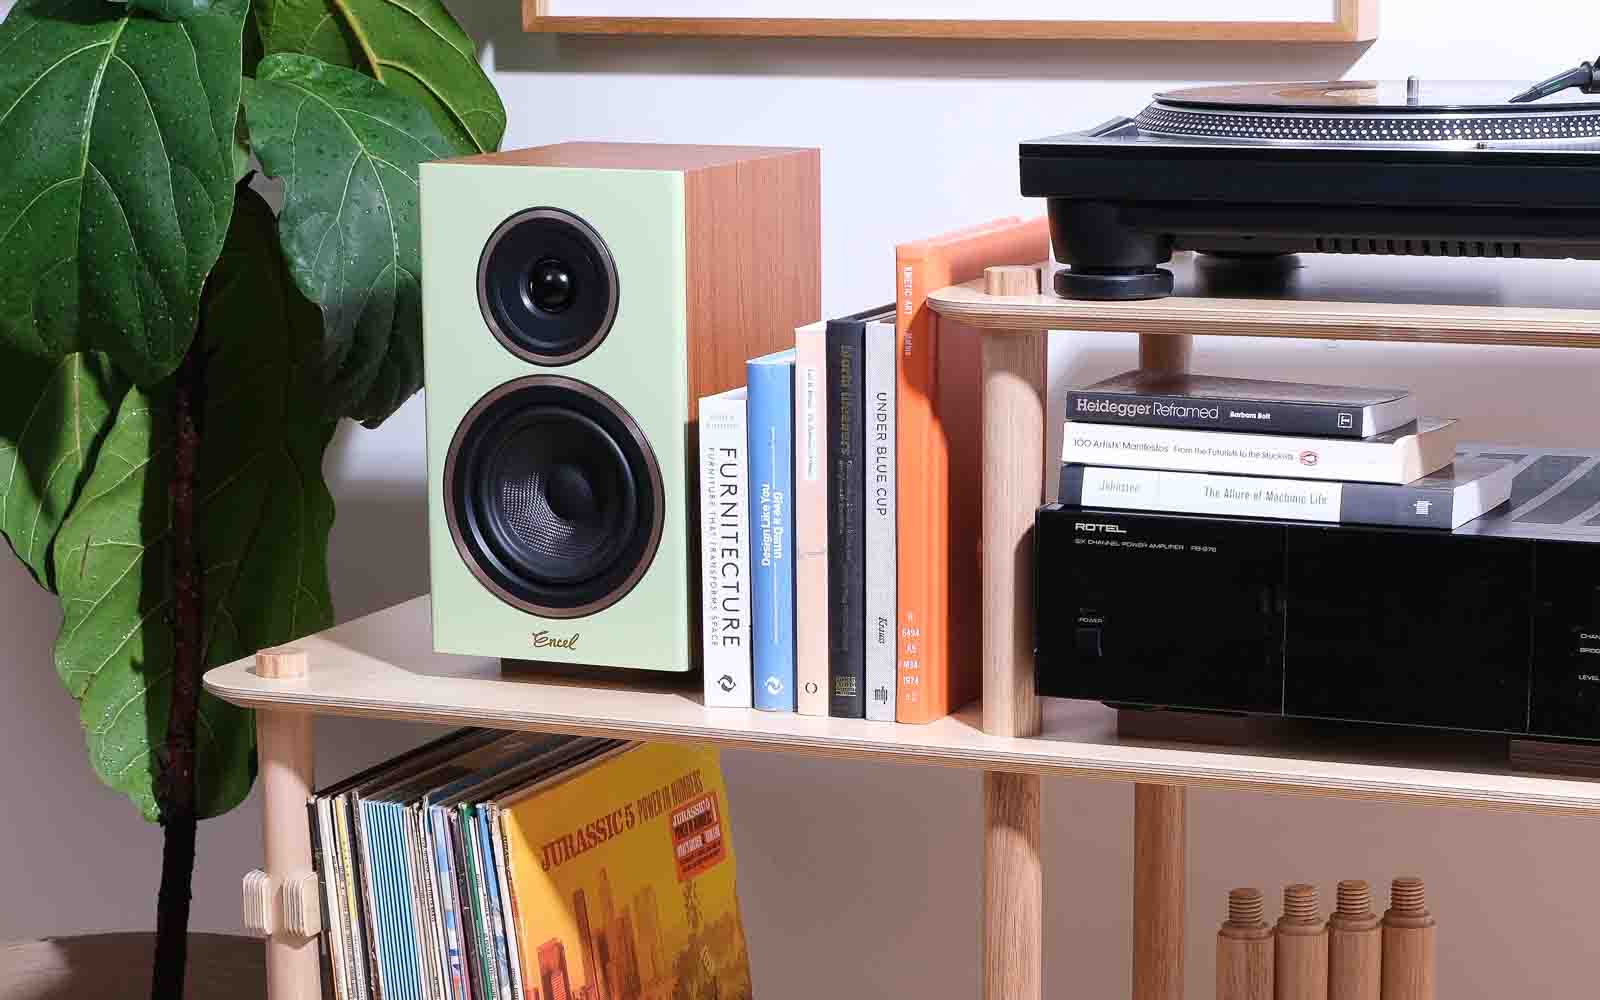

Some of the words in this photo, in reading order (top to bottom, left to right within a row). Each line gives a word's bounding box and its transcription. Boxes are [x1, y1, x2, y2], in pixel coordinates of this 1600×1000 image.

[904, 302, 912, 315] ART
[876, 392, 888, 441] UNDER
[1076, 398, 1151, 416] Heidegger
[1153, 402, 1219, 420] Reframed
[1074, 439, 1092, 448] 100
[1122, 442, 1169, 452] Manifestos
[1174, 446, 1192, 454] From
[1194, 446, 1208, 454] the
[1208, 448, 1238, 457] Futurists
[1248, 450, 1261, 458] the
[706, 447, 717, 506] FURNITURE
[876, 446, 888, 483] BLUE
[760, 483, 770, 504] You
[877, 487, 888, 517] CUP
[1204, 486, 1220, 497] The
[1223, 488, 1250, 500] Allure
[1253, 489, 1262, 501] of
[1310, 492, 1328, 504] Life
[708, 512, 718, 536] THAT
[760, 505, 770, 528] Like
[1074, 522, 1127, 534] ROTEL
[718, 448, 741, 648] FURNITECTURE
[761, 528, 772, 567] Design
[1088, 539, 1120, 547] CHANNEL
[1149, 543, 1184, 551] AMPLIFIER
[710, 541, 719, 611] TRANSFORMS
[532, 630, 580, 650] Encel
[711, 616, 719, 647] SPACE
[637, 793, 663, 825] POWER
[672, 800, 706, 824] JURASSIC
[541, 810, 625, 872] JURASSIC
[623, 802, 636, 830] 5
